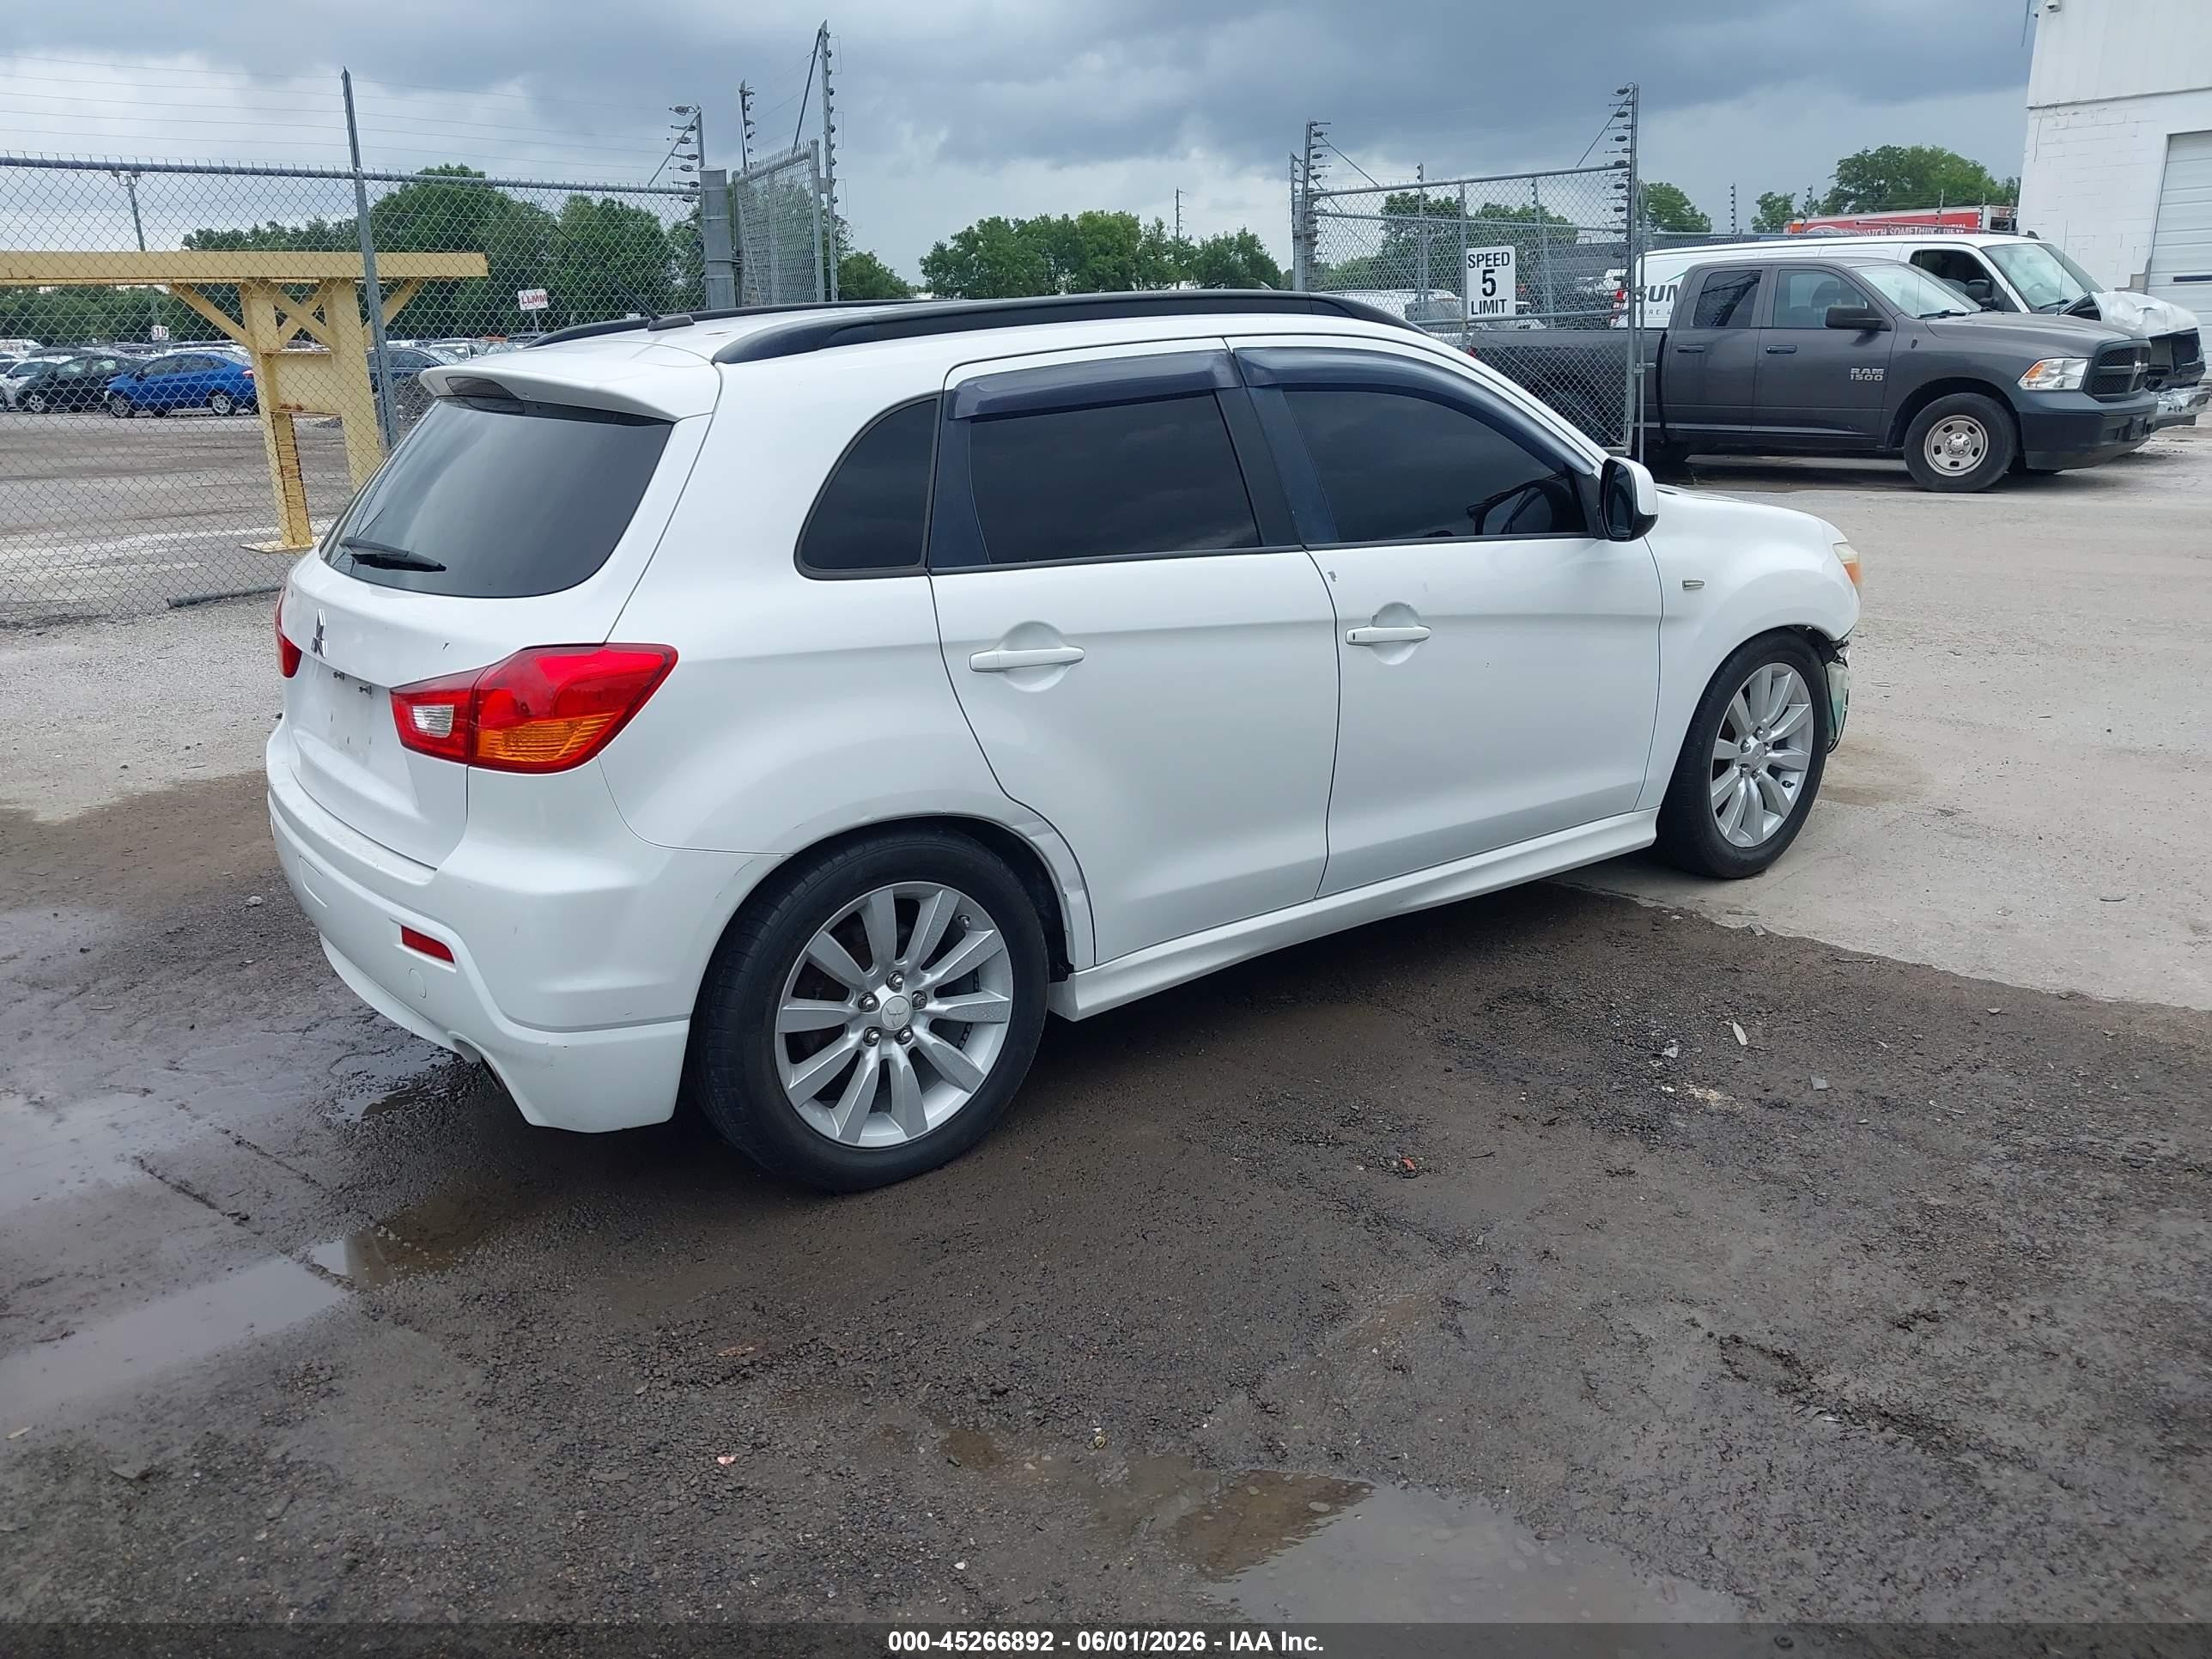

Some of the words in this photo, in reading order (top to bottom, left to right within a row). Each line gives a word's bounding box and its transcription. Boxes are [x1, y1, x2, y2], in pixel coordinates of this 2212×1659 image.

[1468, 252, 1510, 269] SPEED
[1482, 269, 1497, 297] 5
[1471, 298, 1508, 315] LIMIT
